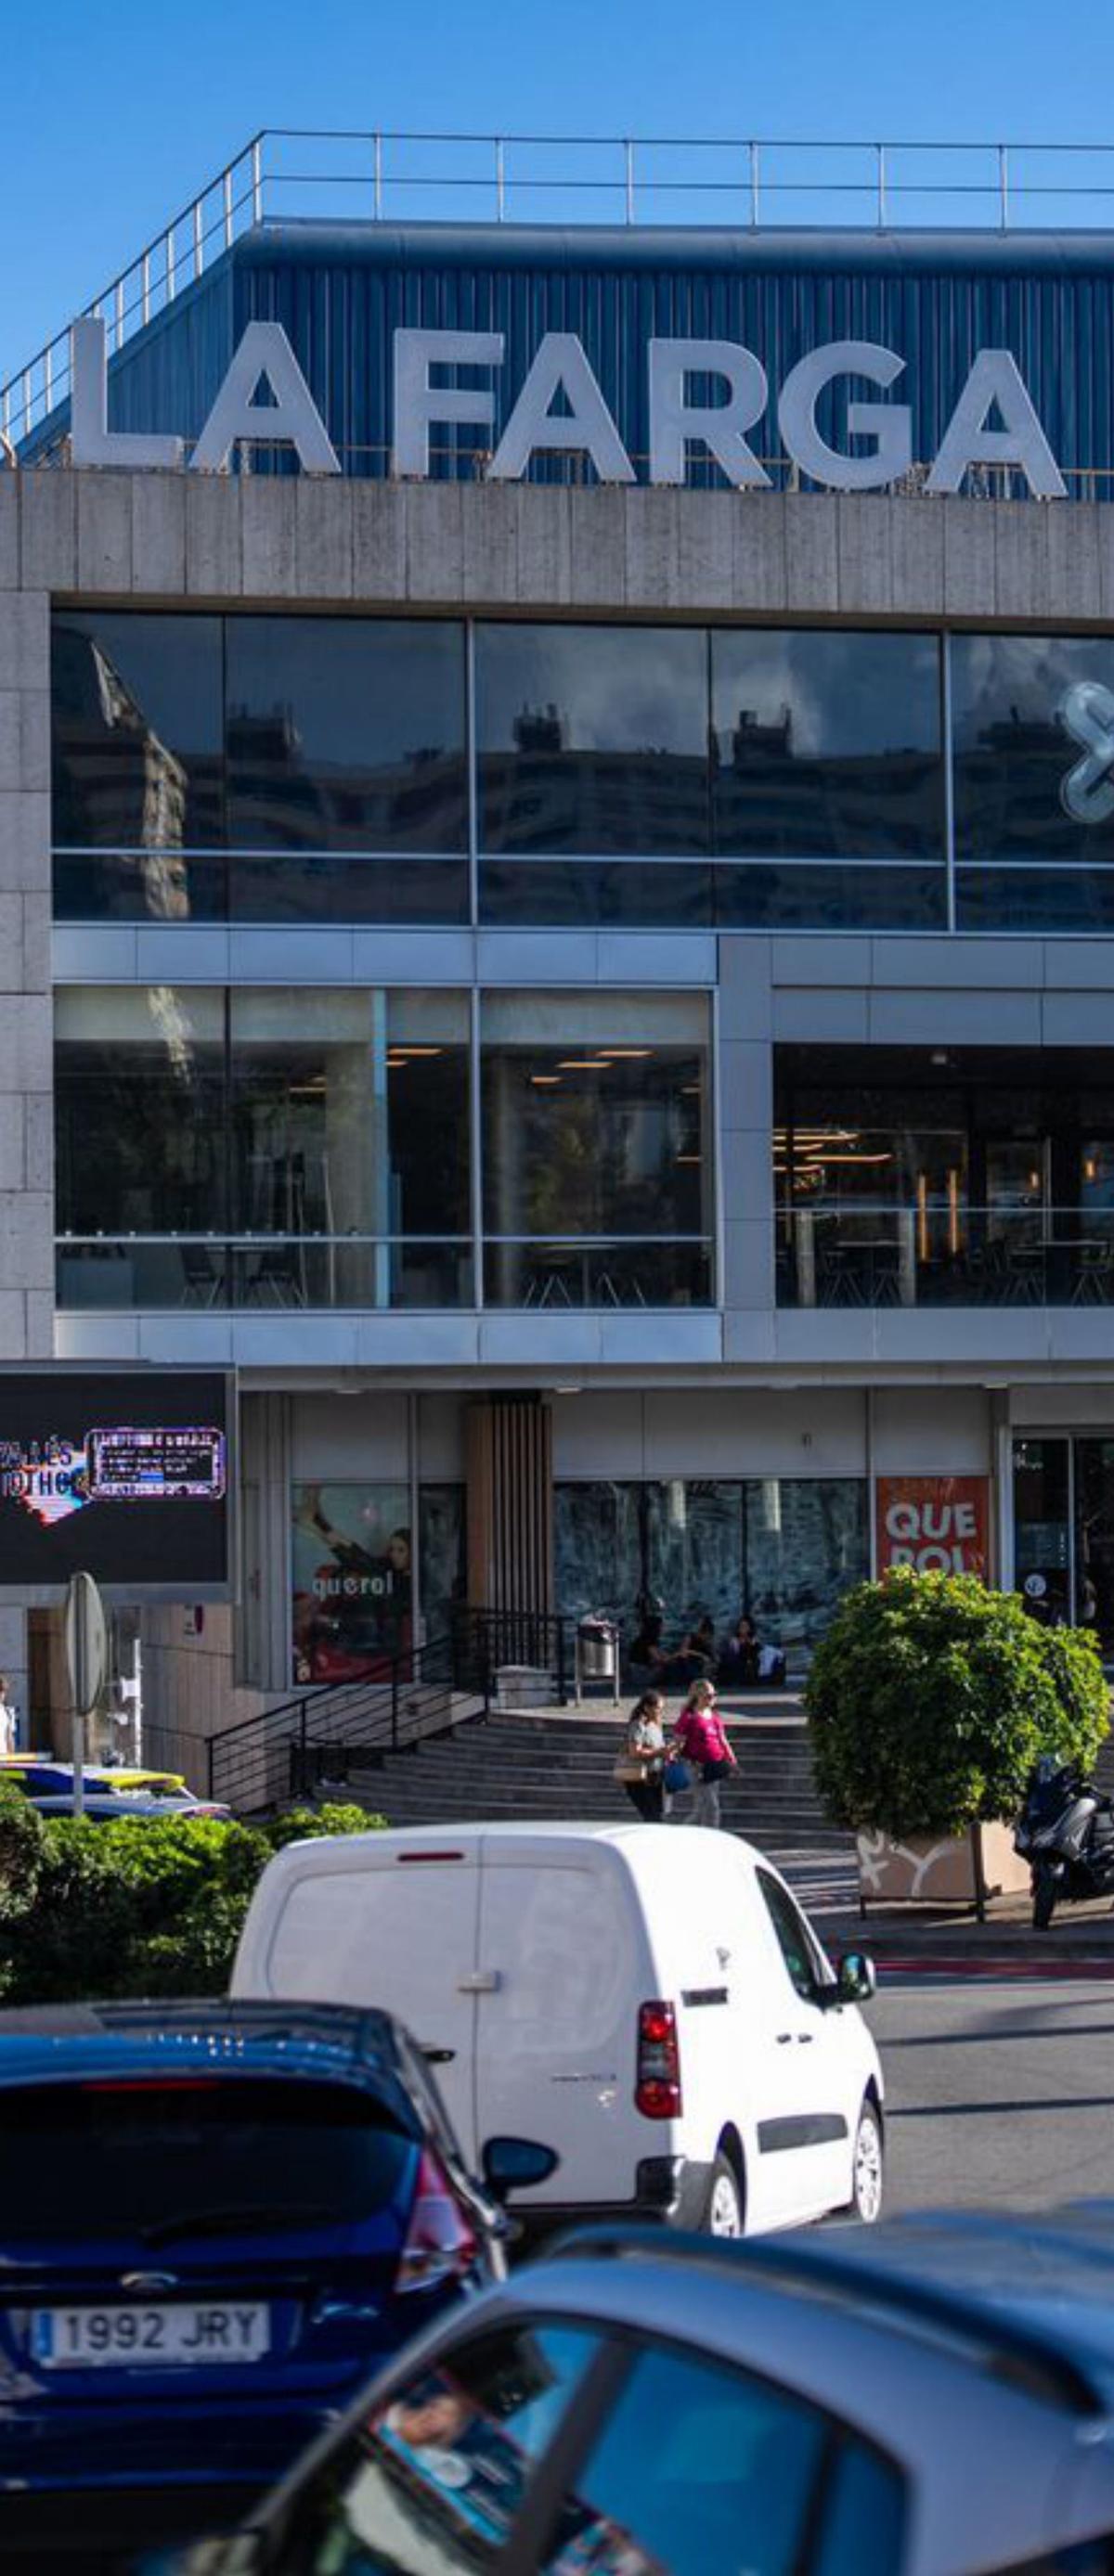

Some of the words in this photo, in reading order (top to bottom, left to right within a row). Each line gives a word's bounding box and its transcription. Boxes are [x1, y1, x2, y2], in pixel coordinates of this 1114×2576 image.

[71, 316, 342, 473] LA
[394, 328, 1069, 497] FARGA
[885, 1502, 978, 1540] QUE
[312, 1571, 394, 1602] querol
[64, 2312, 164, 2351] 1992
[181, 2309, 258, 2348] JRY
